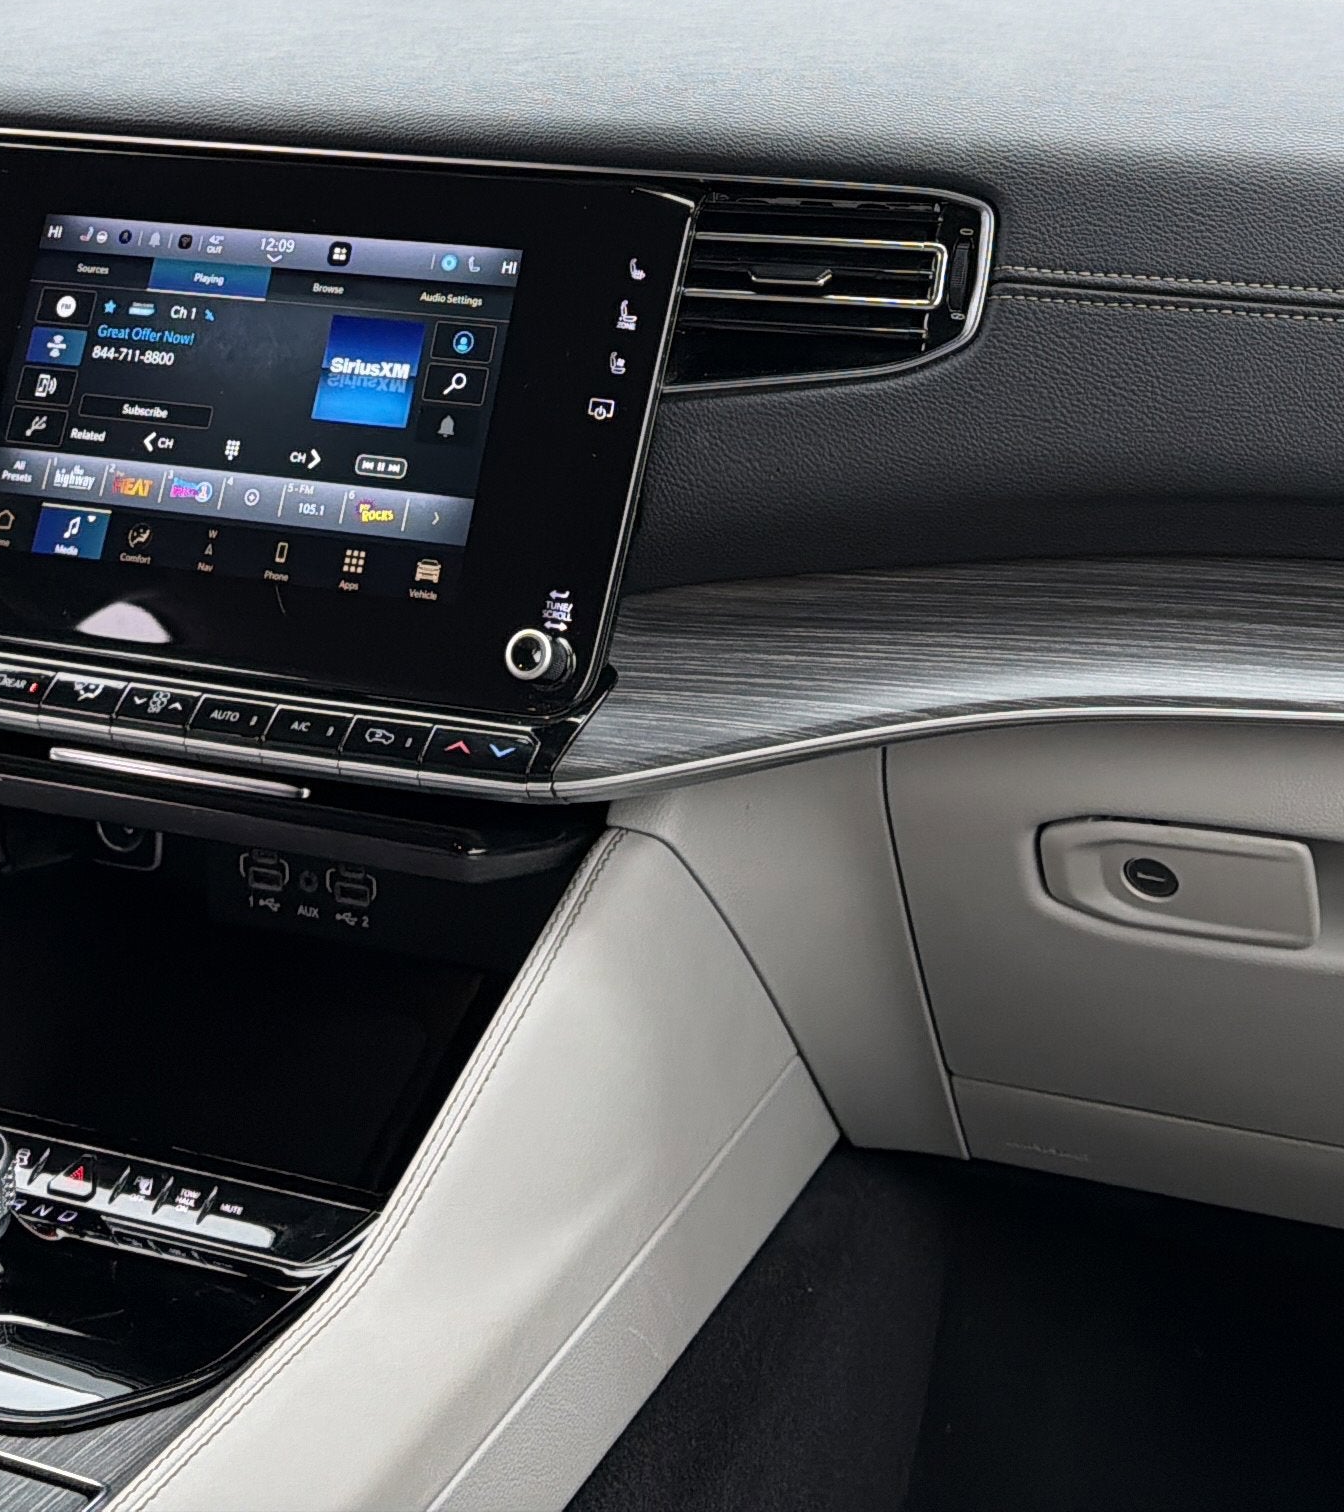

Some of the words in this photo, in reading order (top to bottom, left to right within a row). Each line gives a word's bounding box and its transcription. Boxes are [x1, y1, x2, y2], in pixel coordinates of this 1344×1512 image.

[46, 225, 63, 239] HI
[259, 237, 296, 253] 12:09
[76, 262, 110, 275] Sources
[500, 260, 518, 275] HI
[193, 272, 225, 286] Playing
[312, 282, 345, 295] Browse
[419, 292, 446, 304] Audio
[446, 294, 484, 308] Settings
[170, 305, 188, 319] Ch
[97, 324, 129, 339] Great
[131, 326, 160, 342] Offer
[162, 329, 196, 346] Now!
[91, 345, 175, 366] 844-711-8800
[329, 357, 410, 379] SiriusXM
[121, 403, 169, 419] Subscribe
[70, 428, 107, 442] Related
[157, 438, 175, 450] CH
[289, 452, 307, 464] CH
[13, 460, 27, 471] All
[1, 470, 33, 484] Presets
[348, 490, 356, 500] 6
[298, 502, 325, 516] 105.1
[54, 544, 79, 556] Media
[119, 551, 151, 565] Comfort
[197, 561, 214, 573] Nav
[263, 570, 289, 582] Phone
[338, 579, 359, 591] Apps
[409, 588, 438, 601] Vehicle
[209, 708, 240, 723] AUTO
[290, 720, 312, 733] A/C
[297, 903, 320, 920] AUX
[32, 1202, 54, 1217] N
[220, 1202, 244, 1215] MUTE
